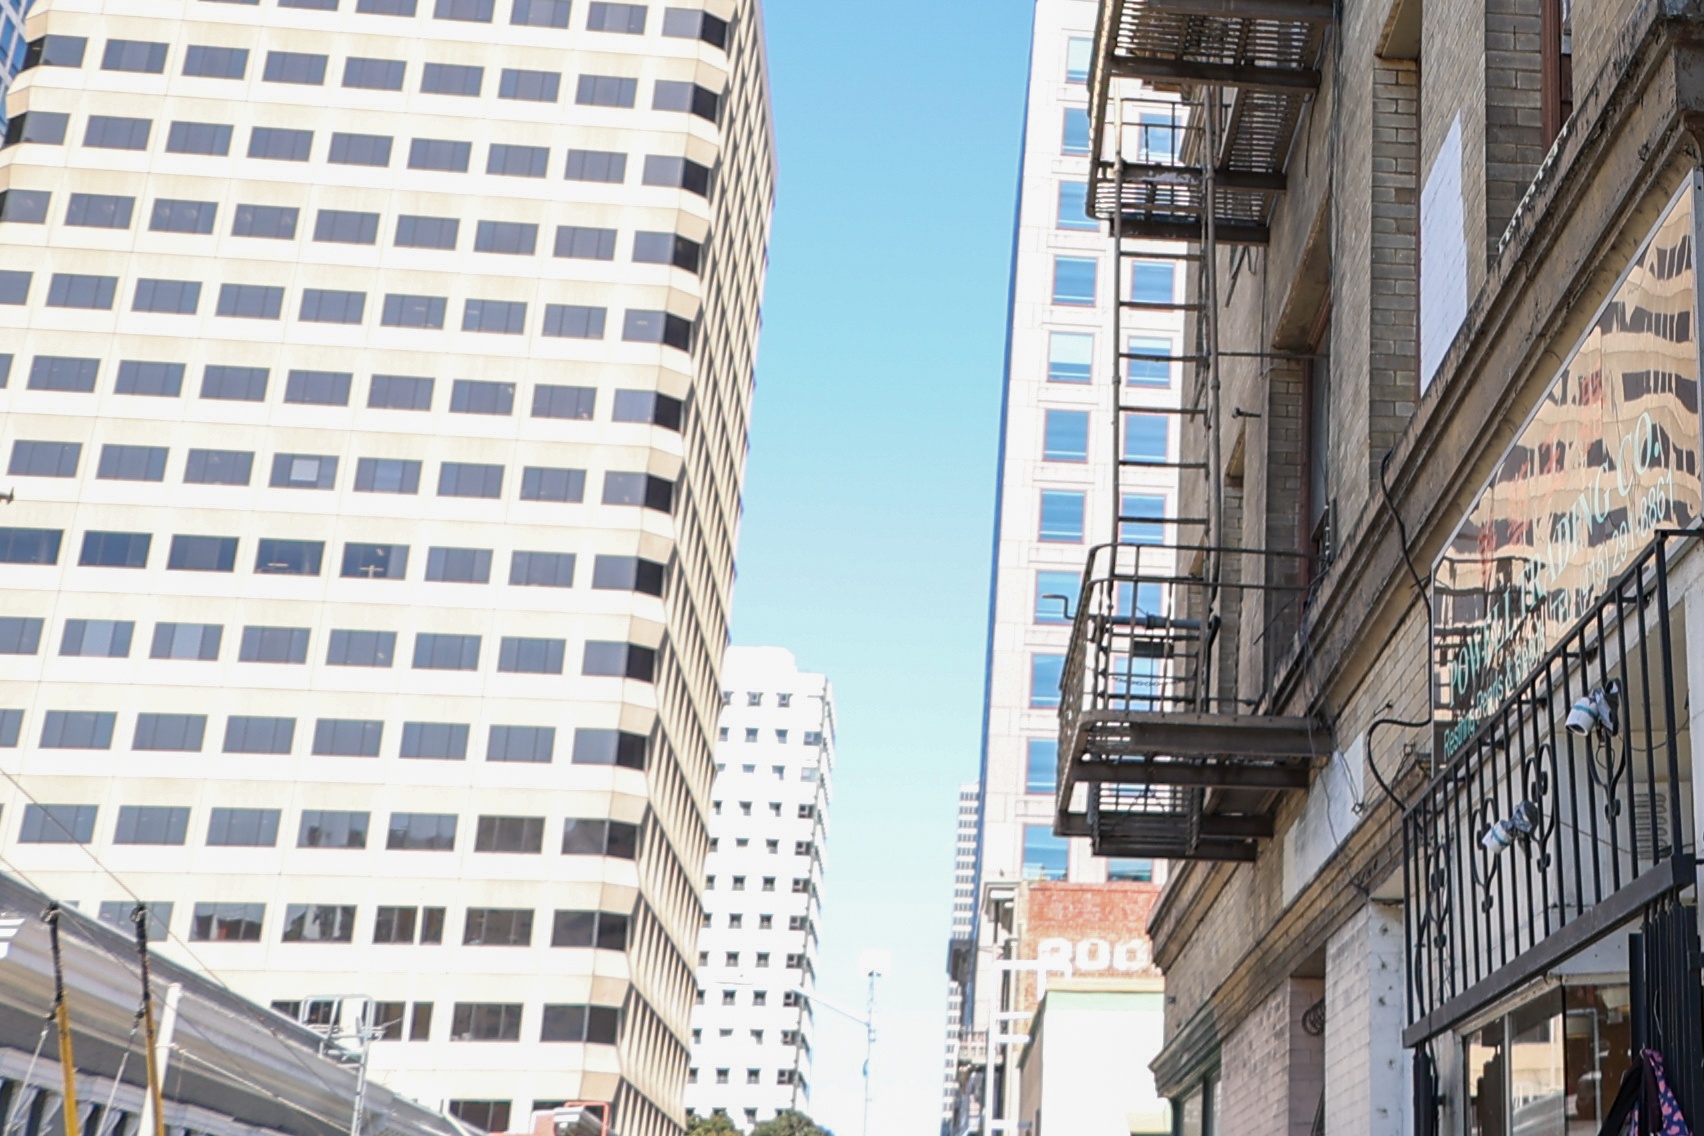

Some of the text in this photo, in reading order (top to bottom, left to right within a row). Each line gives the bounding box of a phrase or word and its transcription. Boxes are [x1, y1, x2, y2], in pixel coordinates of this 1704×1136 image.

[1449, 586, 1516, 708] POWELL
[1517, 458, 1611, 621] TRADING
[1616, 411, 1661, 497] CO.
[1612, 465, 1675, 573] 291-8861
